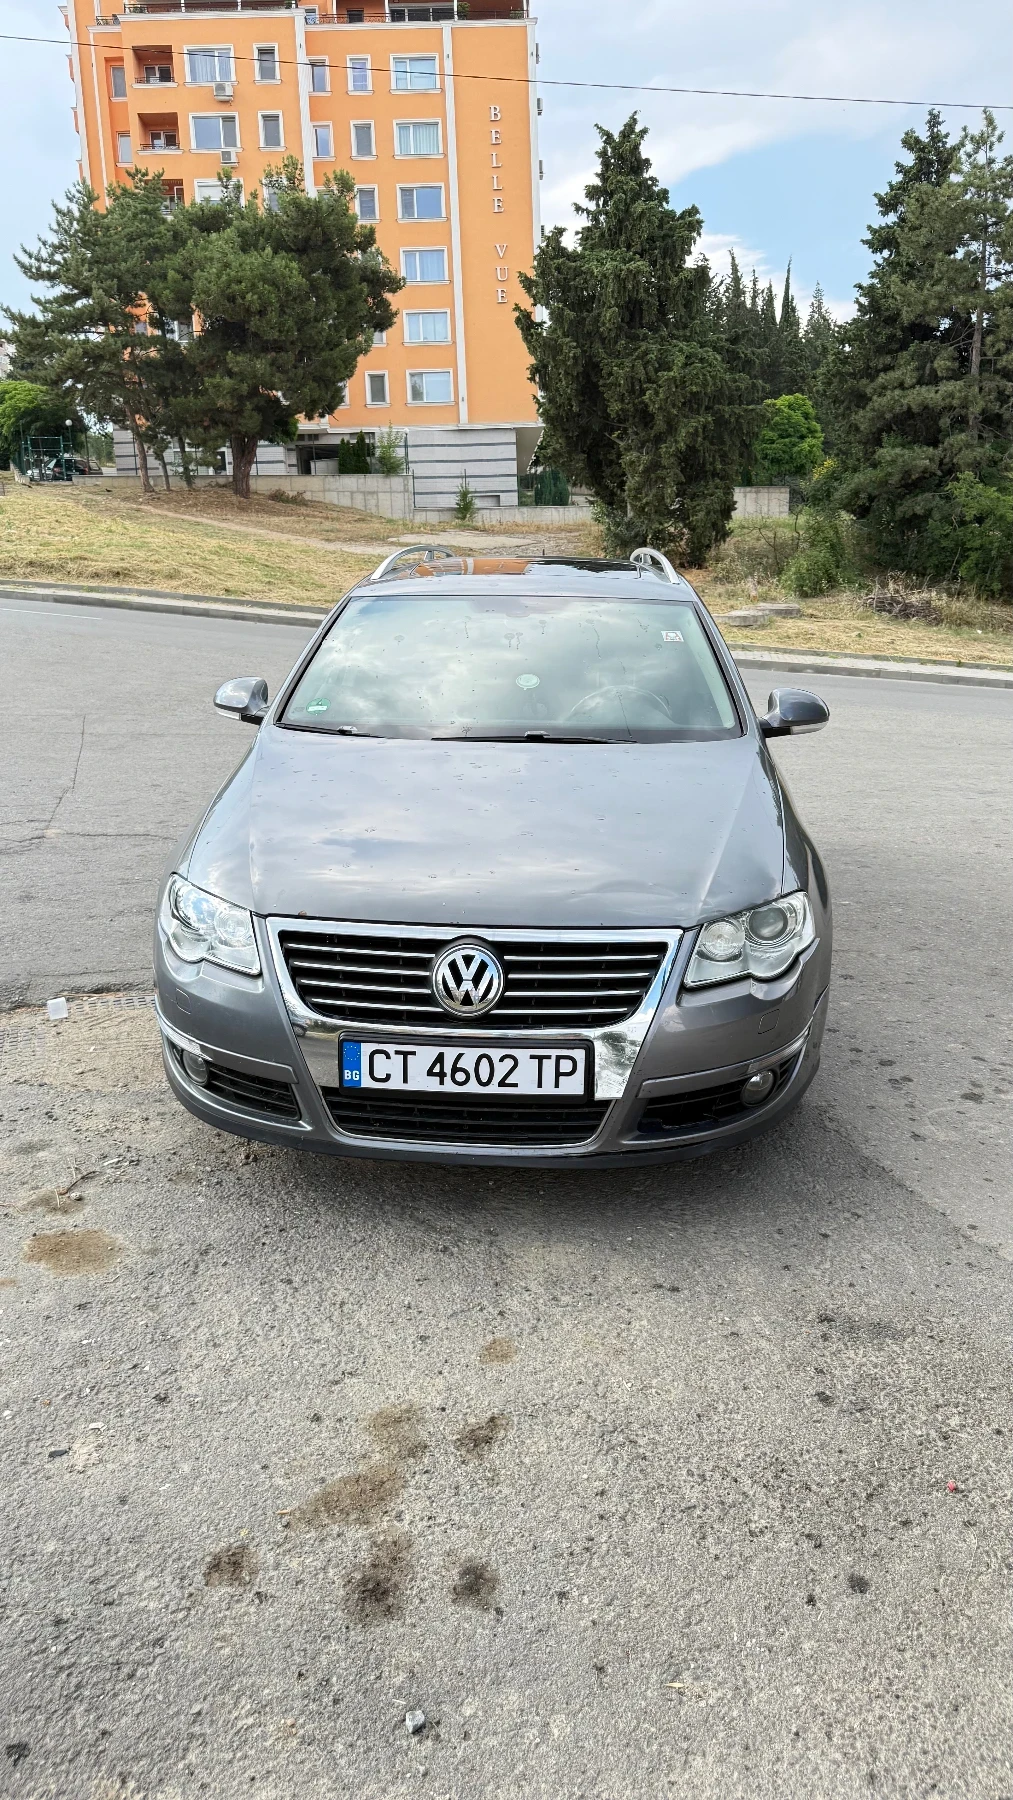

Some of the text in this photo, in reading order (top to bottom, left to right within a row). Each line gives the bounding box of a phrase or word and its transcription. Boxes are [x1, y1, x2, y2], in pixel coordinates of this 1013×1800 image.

[489, 105, 509, 304] BELLE VUE
[436, 948, 499, 1012] VW
[344, 1070, 360, 1081] BG
[368, 1049, 578, 1089] CT 4602 TP
